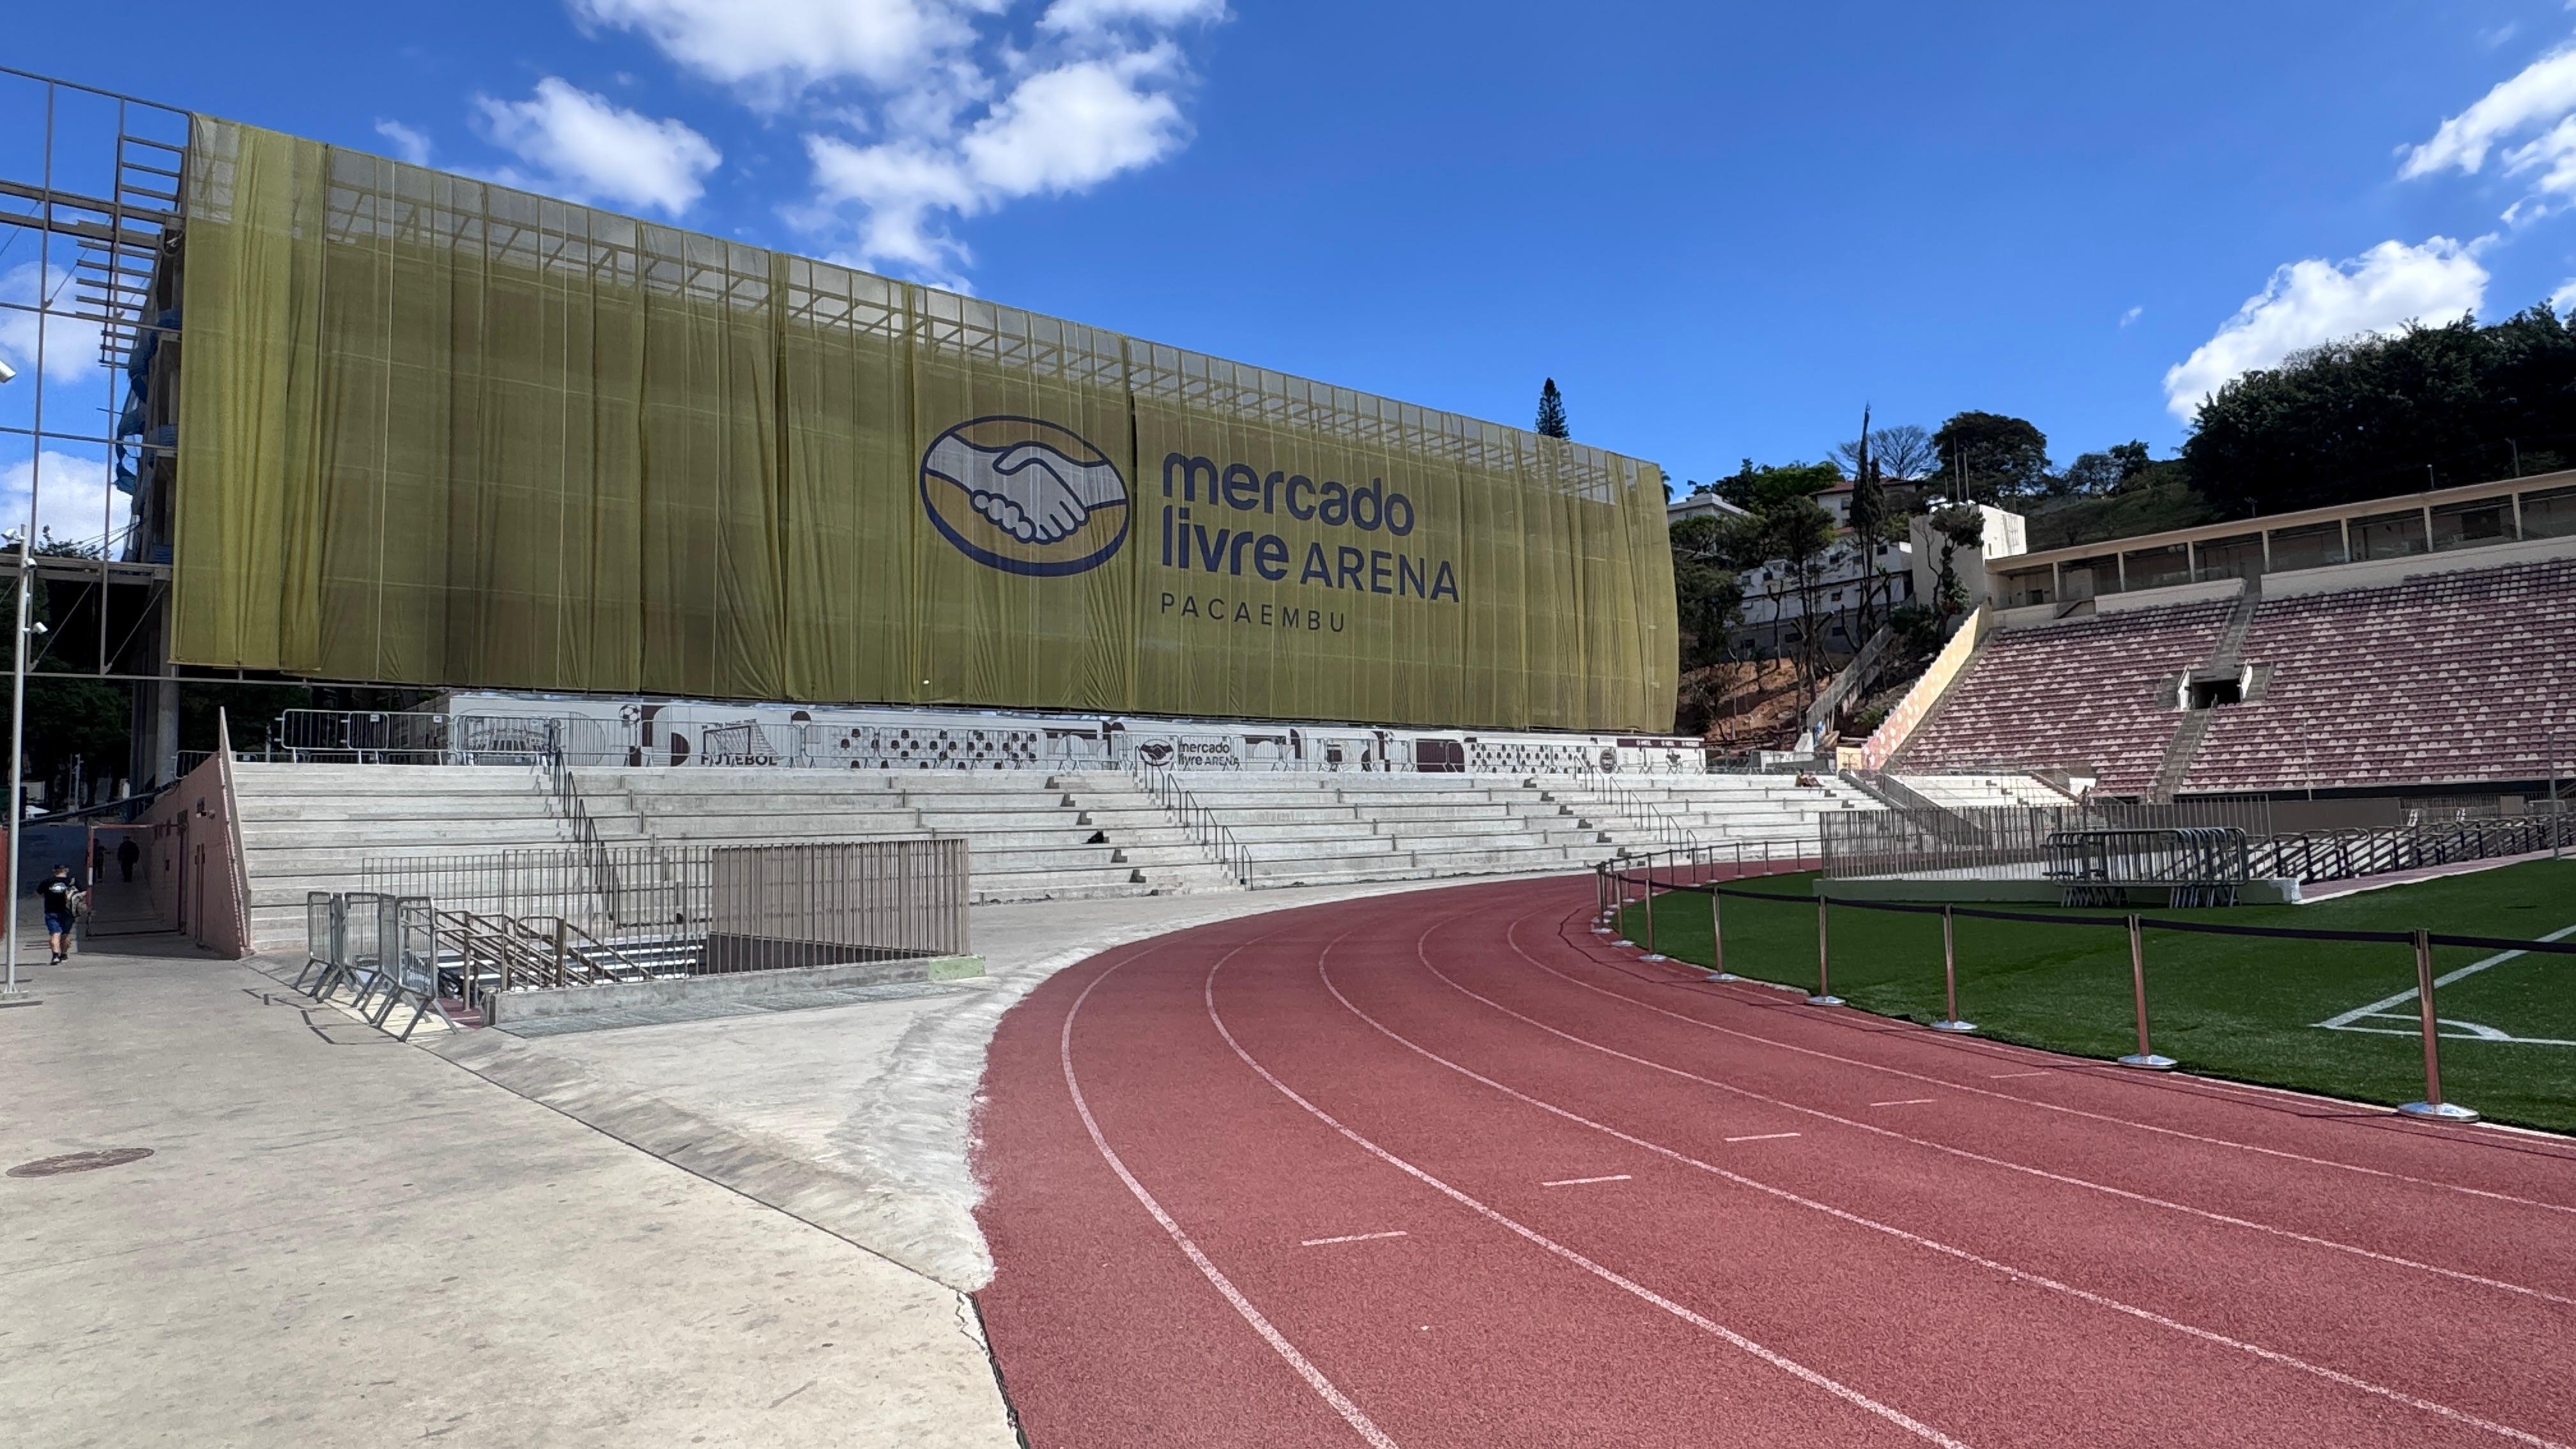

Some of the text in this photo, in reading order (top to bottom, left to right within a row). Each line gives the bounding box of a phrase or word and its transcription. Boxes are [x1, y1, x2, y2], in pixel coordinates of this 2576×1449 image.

[1163, 452, 1414, 536] mercado
[1162, 506, 1460, 603] livre ARENA
[1161, 592, 1346, 632] PACAEMBU
[701, 753, 778, 766] FUTEBOL
[1178, 742, 1230, 753] mercado
[1178, 753, 1202, 765] livre
